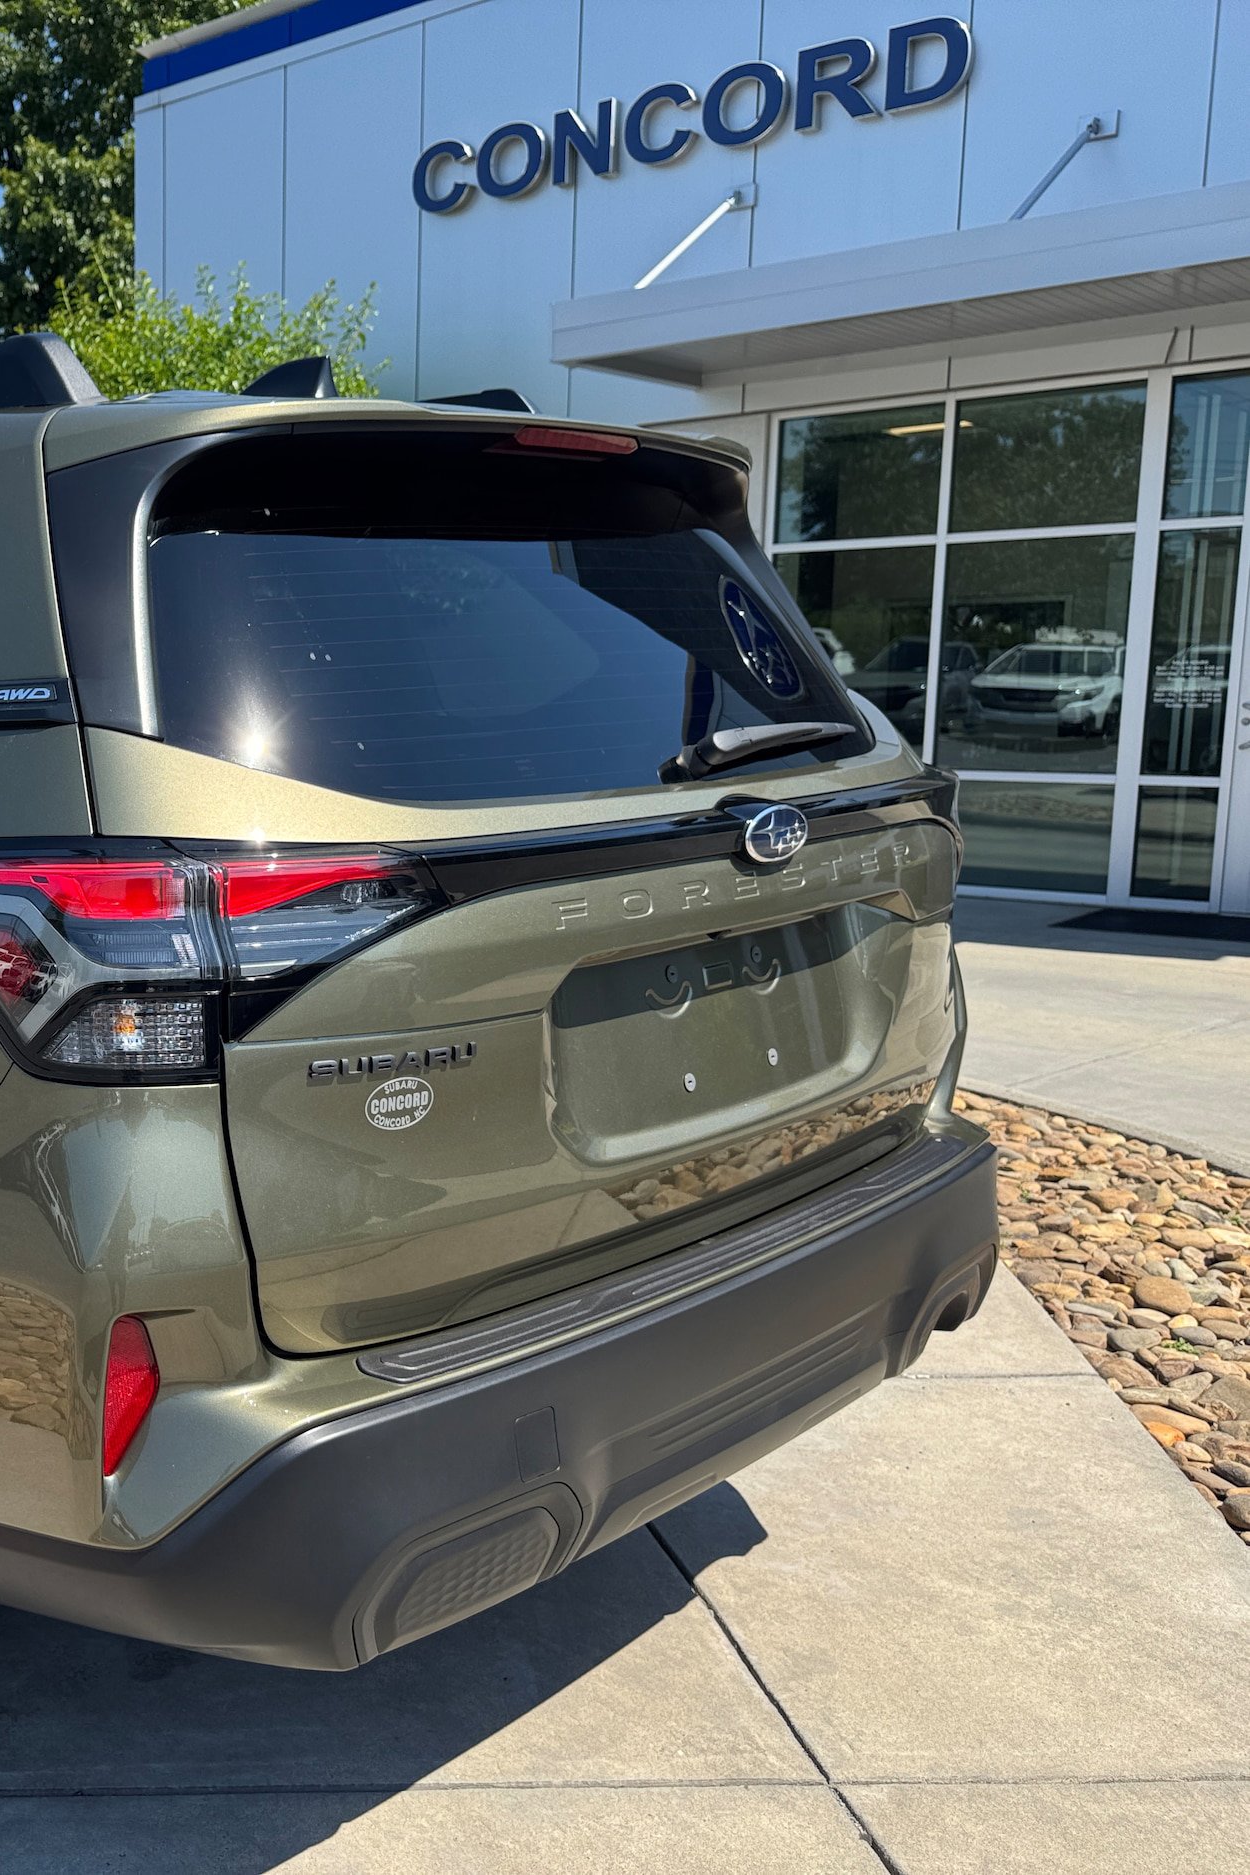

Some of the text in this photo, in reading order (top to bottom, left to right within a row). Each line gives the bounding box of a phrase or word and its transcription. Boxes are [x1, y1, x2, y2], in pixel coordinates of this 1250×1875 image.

[411, 15, 973, 215] CONCORD
[551, 841, 911, 931] FORESTER
[307, 1041, 478, 1079] SUBARU
[370, 1090, 430, 1115] CONCORD
[384, 1080, 418, 1095] SUBARU
[373, 1113, 412, 1128] CONCORD
